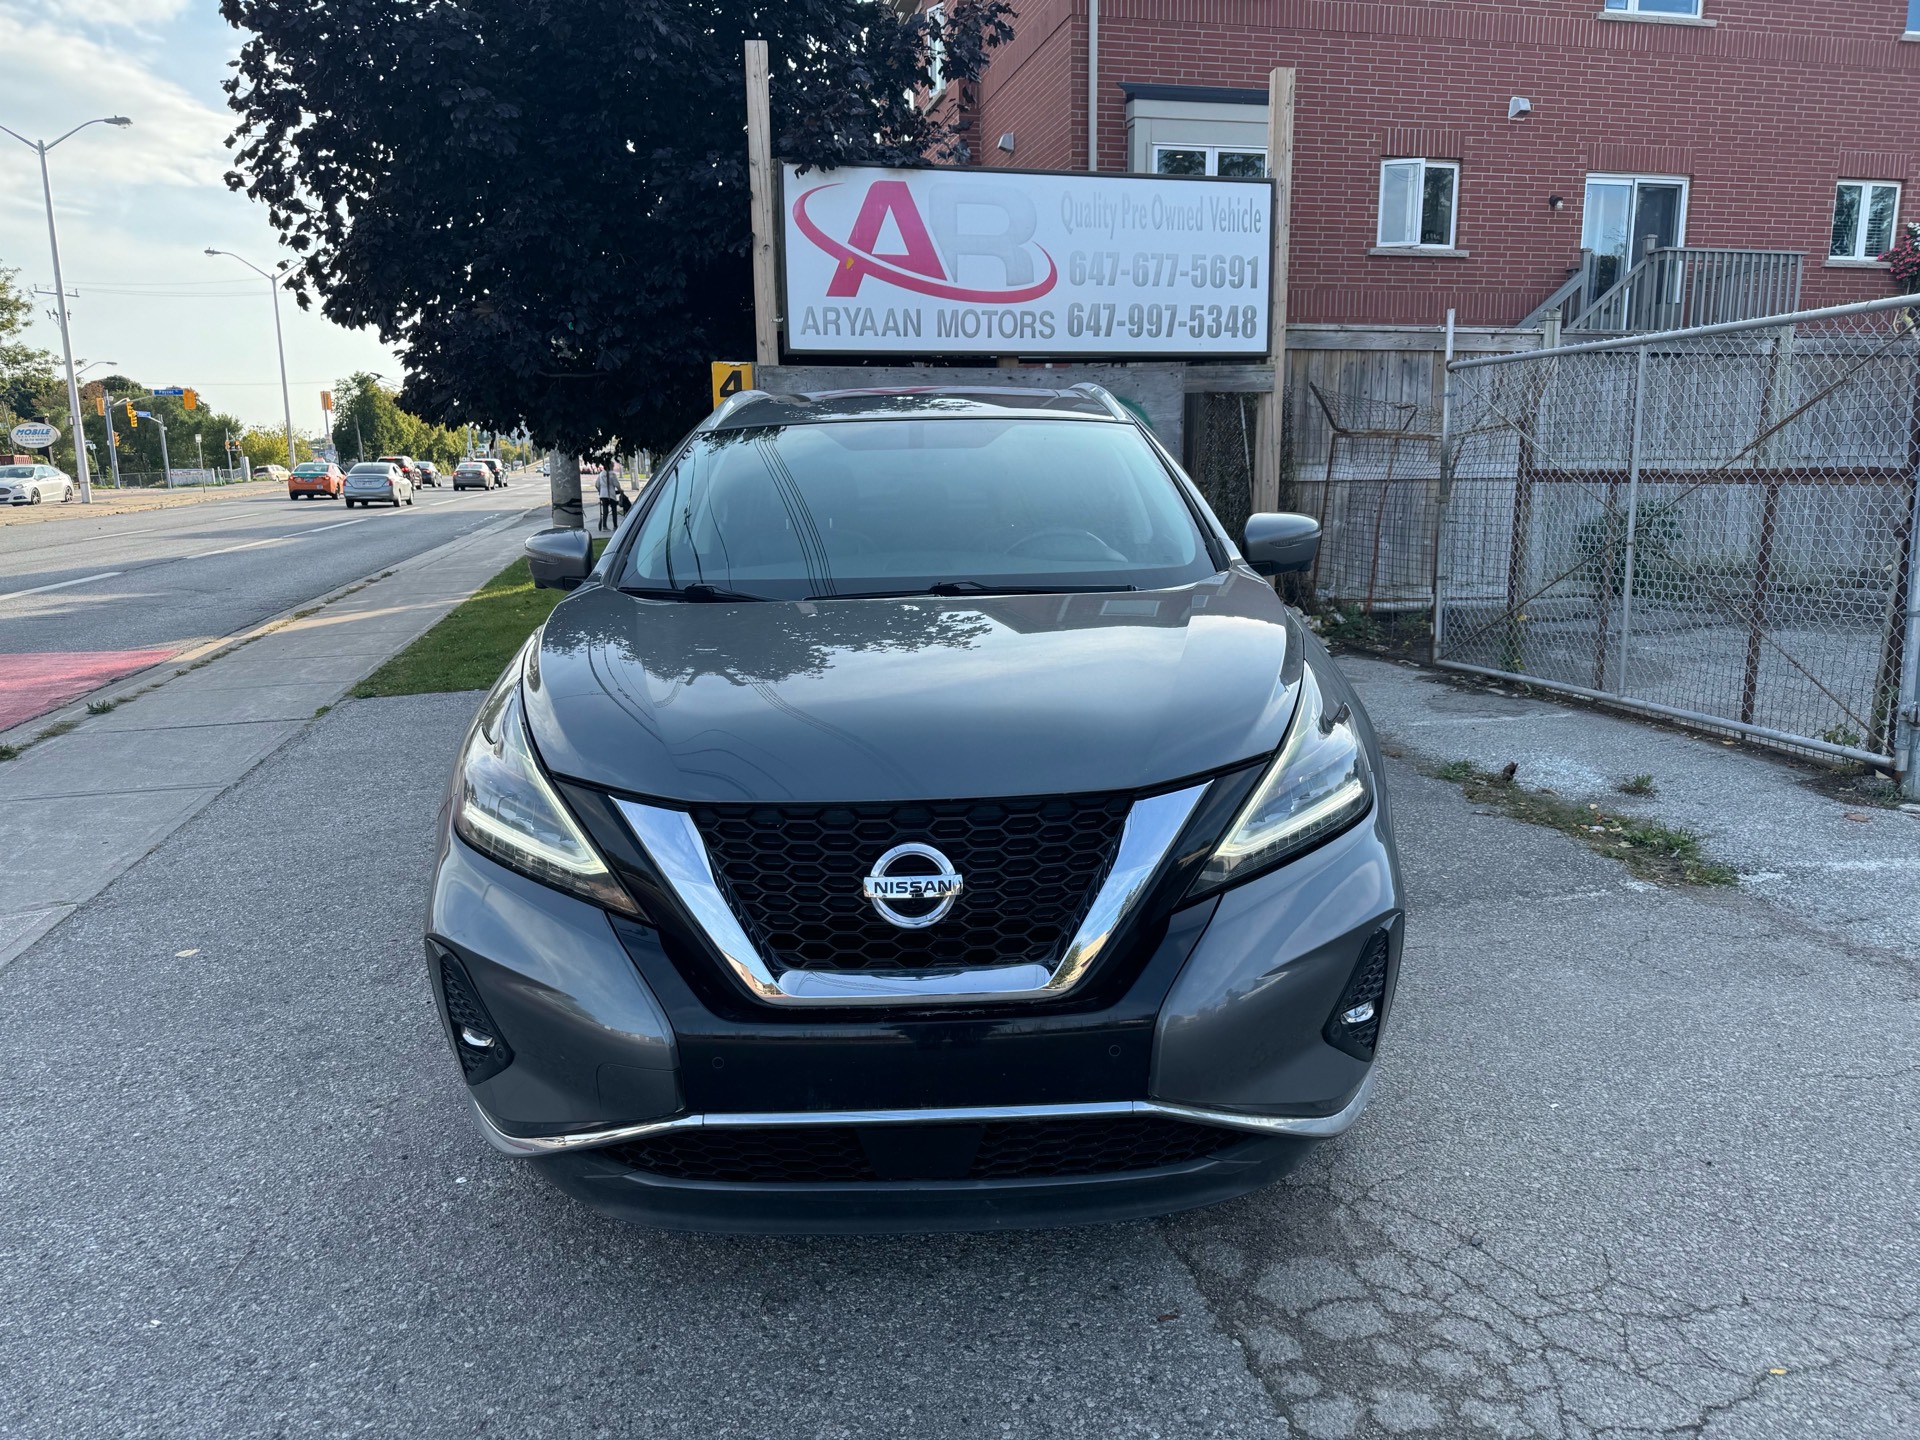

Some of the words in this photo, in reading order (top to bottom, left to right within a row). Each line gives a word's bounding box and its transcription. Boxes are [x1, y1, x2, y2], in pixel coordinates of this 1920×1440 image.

[1061, 191, 1117, 239] Quality
[1122, 193, 1147, 230] Pre
[1151, 194, 1203, 231] Owned
[1210, 196, 1261, 233] Vehicle
[1069, 251, 1259, 289] 647-677-5691
[801, 306, 921, 337] ARYAAN
[937, 309, 1056, 339] MOTORS
[1067, 303, 1257, 338] 647-997-5348
[720, 370, 742, 397] 4
[874, 880, 952, 894] NISSAN
